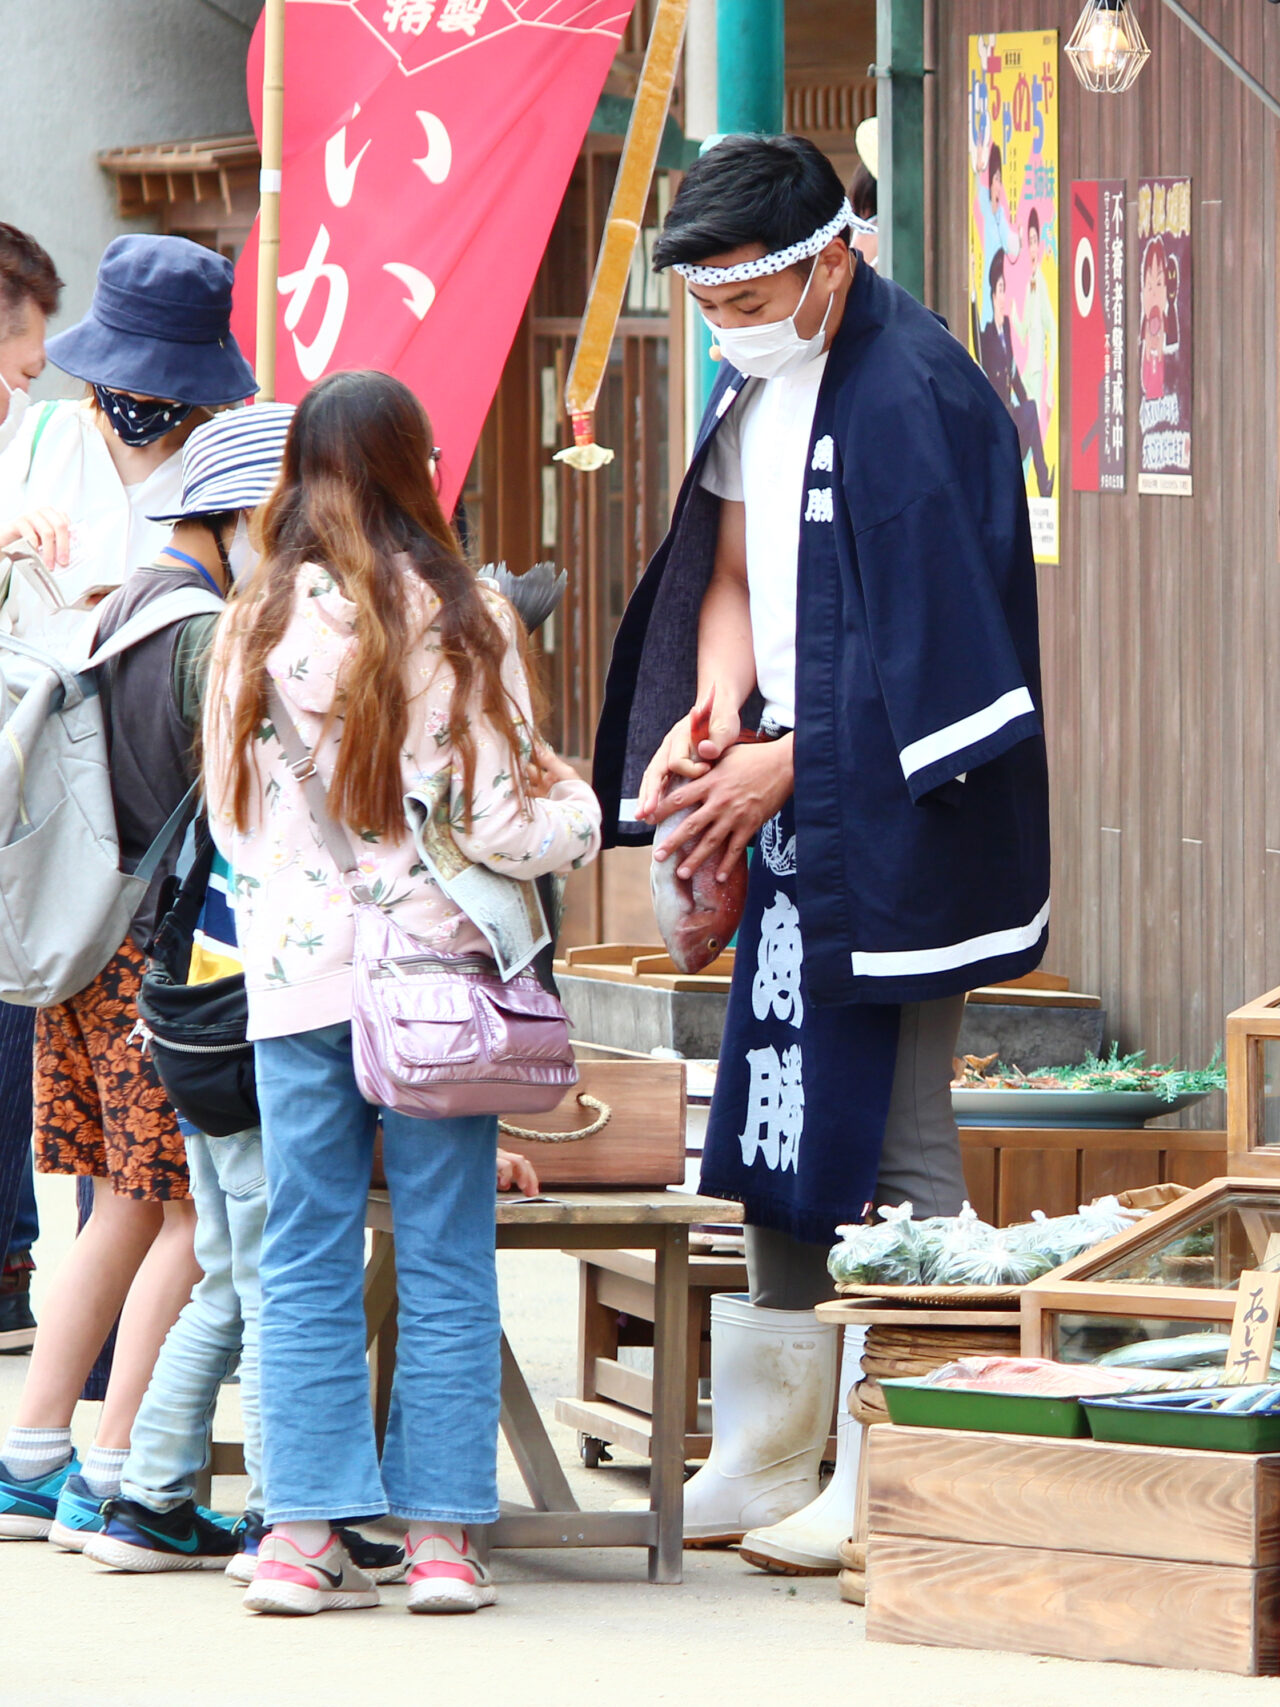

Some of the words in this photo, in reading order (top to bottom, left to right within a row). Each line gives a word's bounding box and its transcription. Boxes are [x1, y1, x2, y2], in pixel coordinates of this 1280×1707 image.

[277, 102, 452, 381] いか
[738, 889, 806, 1176] 魚勝
[1232, 1287, 1269, 1384] あじ干
